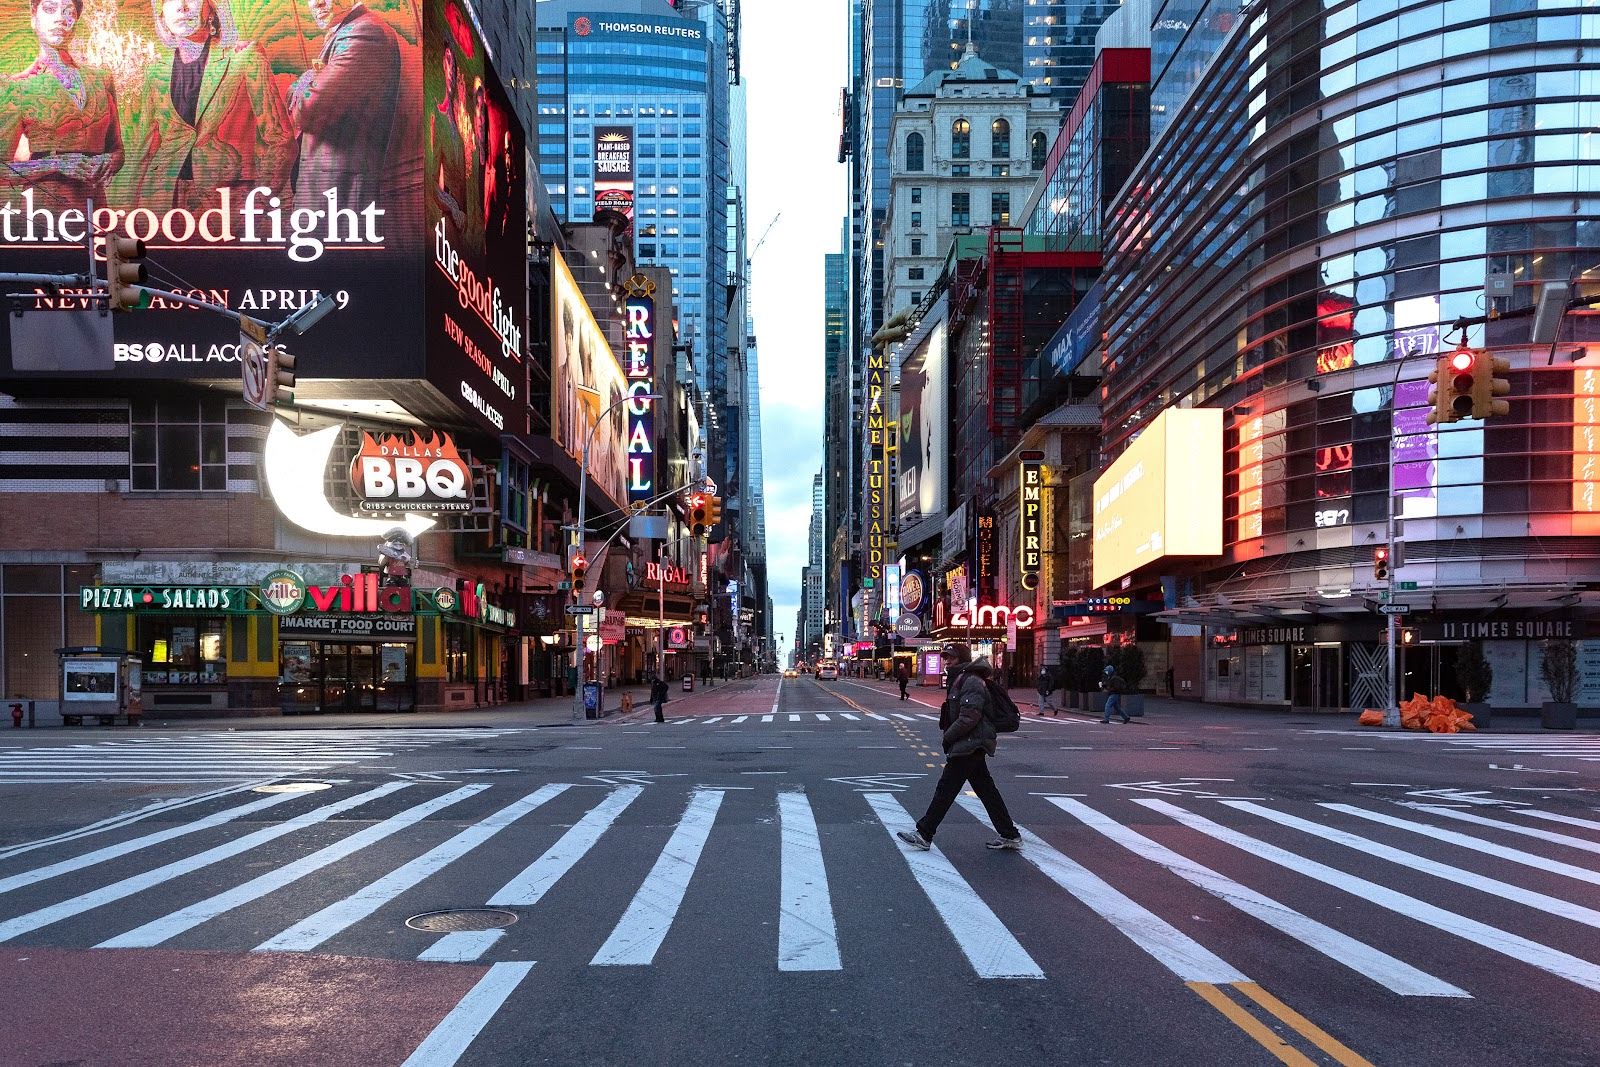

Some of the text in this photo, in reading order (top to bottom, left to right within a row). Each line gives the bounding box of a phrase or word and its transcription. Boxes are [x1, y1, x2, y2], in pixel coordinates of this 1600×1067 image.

[599, 22, 701, 39] THOMSON REUTERS
[597, 143, 630, 151] PLANT-BASED
[597, 152, 630, 160] BREAKFAST
[597, 162, 631, 172] SAUSAGE
[335, 289, 350, 310] 9
[113, 343, 288, 363] BS ALL ACCSS
[444, 312, 464, 348] NEW
[463, 336, 492, 378] SEASON
[492, 365, 511, 397] APRIL
[1051, 328, 1073, 368] IMAX
[626, 305, 652, 491] REGAL
[868, 355, 883, 444] MADAME
[381, 445, 443, 458] DALLAS
[362, 457, 467, 499] BBQ
[1024, 470, 1040, 566] EMPIRE
[83, 588, 230, 609] PIZZA SALADS
[261, 584, 302, 600] villa
[308, 573, 411, 612] villa
[286, 617, 415, 632] MARKET FOOD COURT
[1443, 621, 1572, 638] 11 TIMES SQUARE
[1244, 629, 1266, 643] TIMES
[1268, 627, 1305, 642] SQUARE
